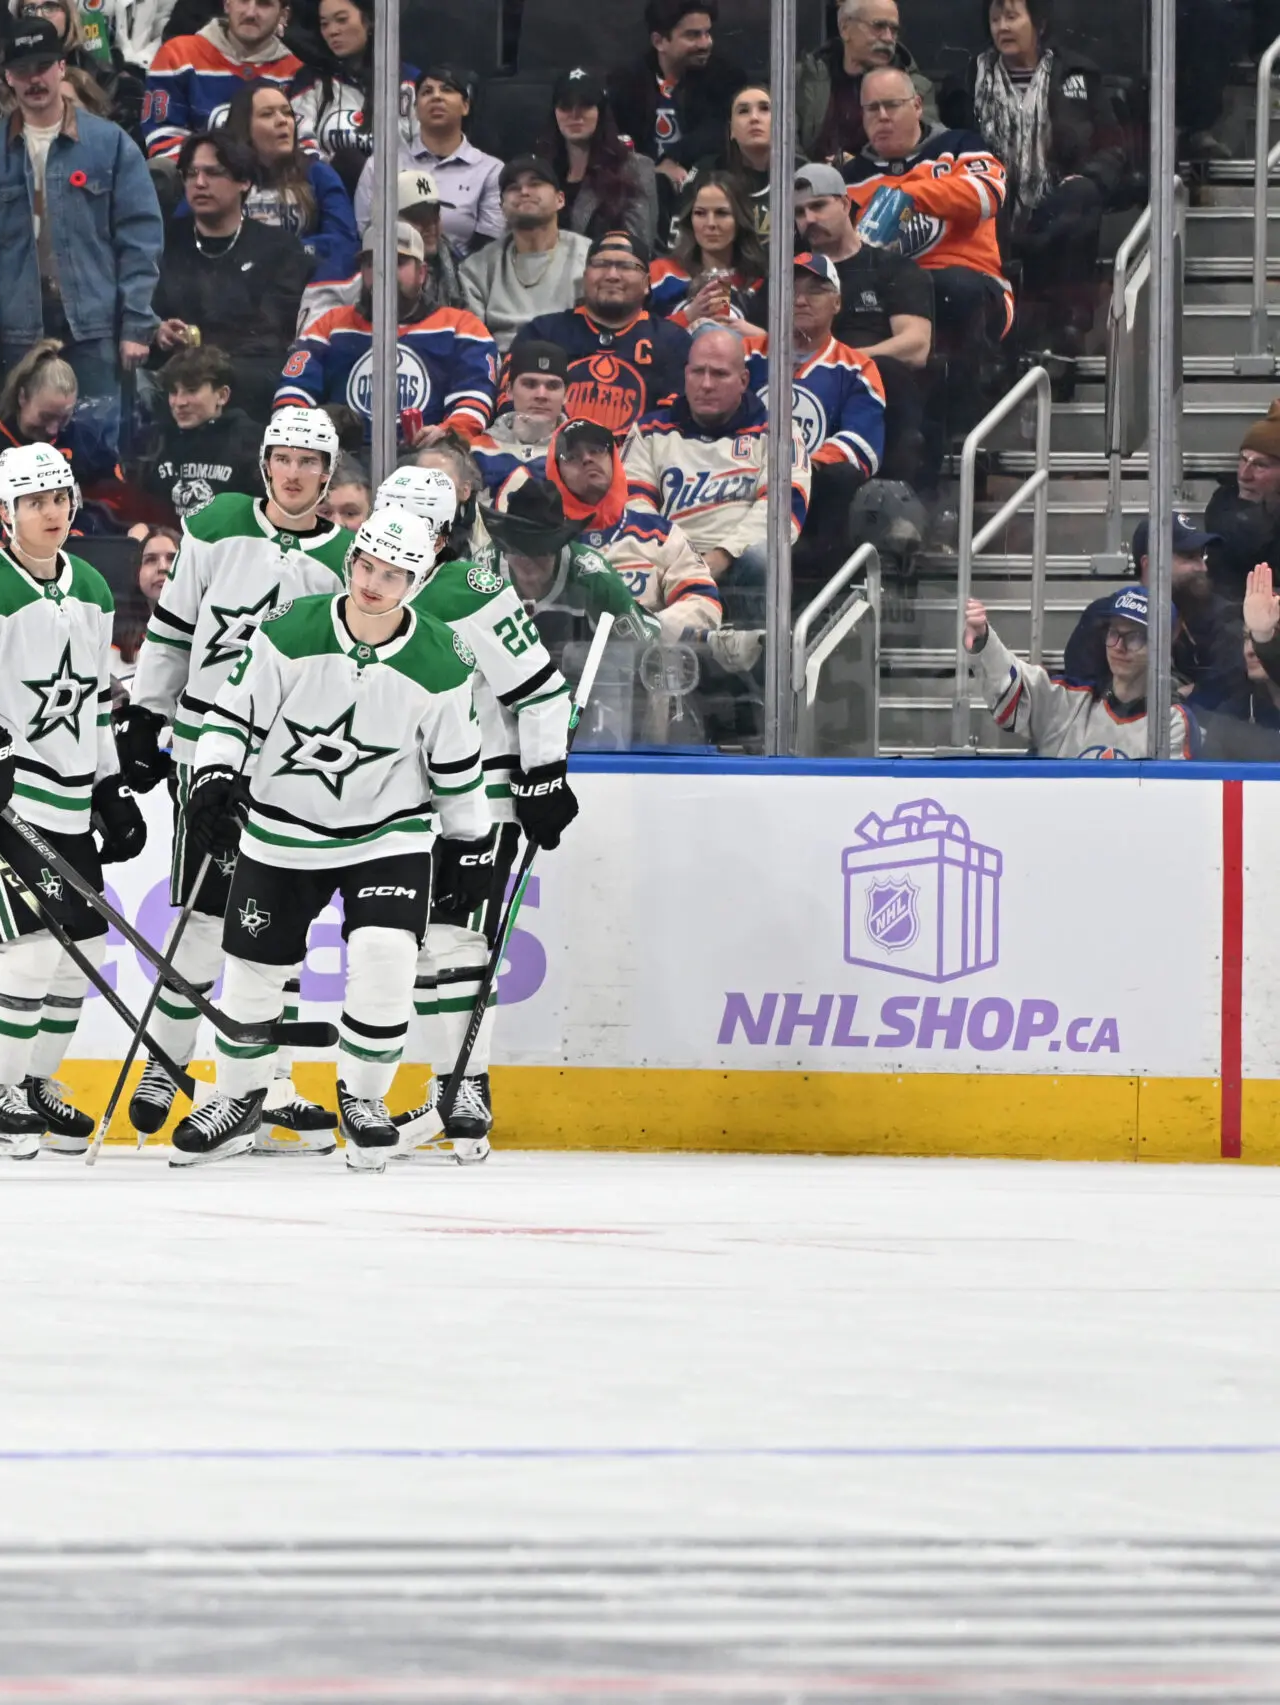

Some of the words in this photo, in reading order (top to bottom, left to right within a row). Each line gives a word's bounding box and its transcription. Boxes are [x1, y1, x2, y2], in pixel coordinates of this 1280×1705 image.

[282, 351, 311, 378] 8
[634, 338, 653, 365] C
[731, 434, 752, 461] C
[37, 469, 60, 478] CCM
[158, 462, 179, 479] ST.
[181, 462, 233, 482] EDMUND
[376, 538, 401, 552] CCM
[493, 608, 540, 658] 22
[510, 777, 563, 797] AUER
[17, 824, 57, 860] BAUER
[357, 886, 417, 900] CCM
[876, 897, 907, 934] NHL
[717, 992, 1120, 1053] NHLSHOP.CA
